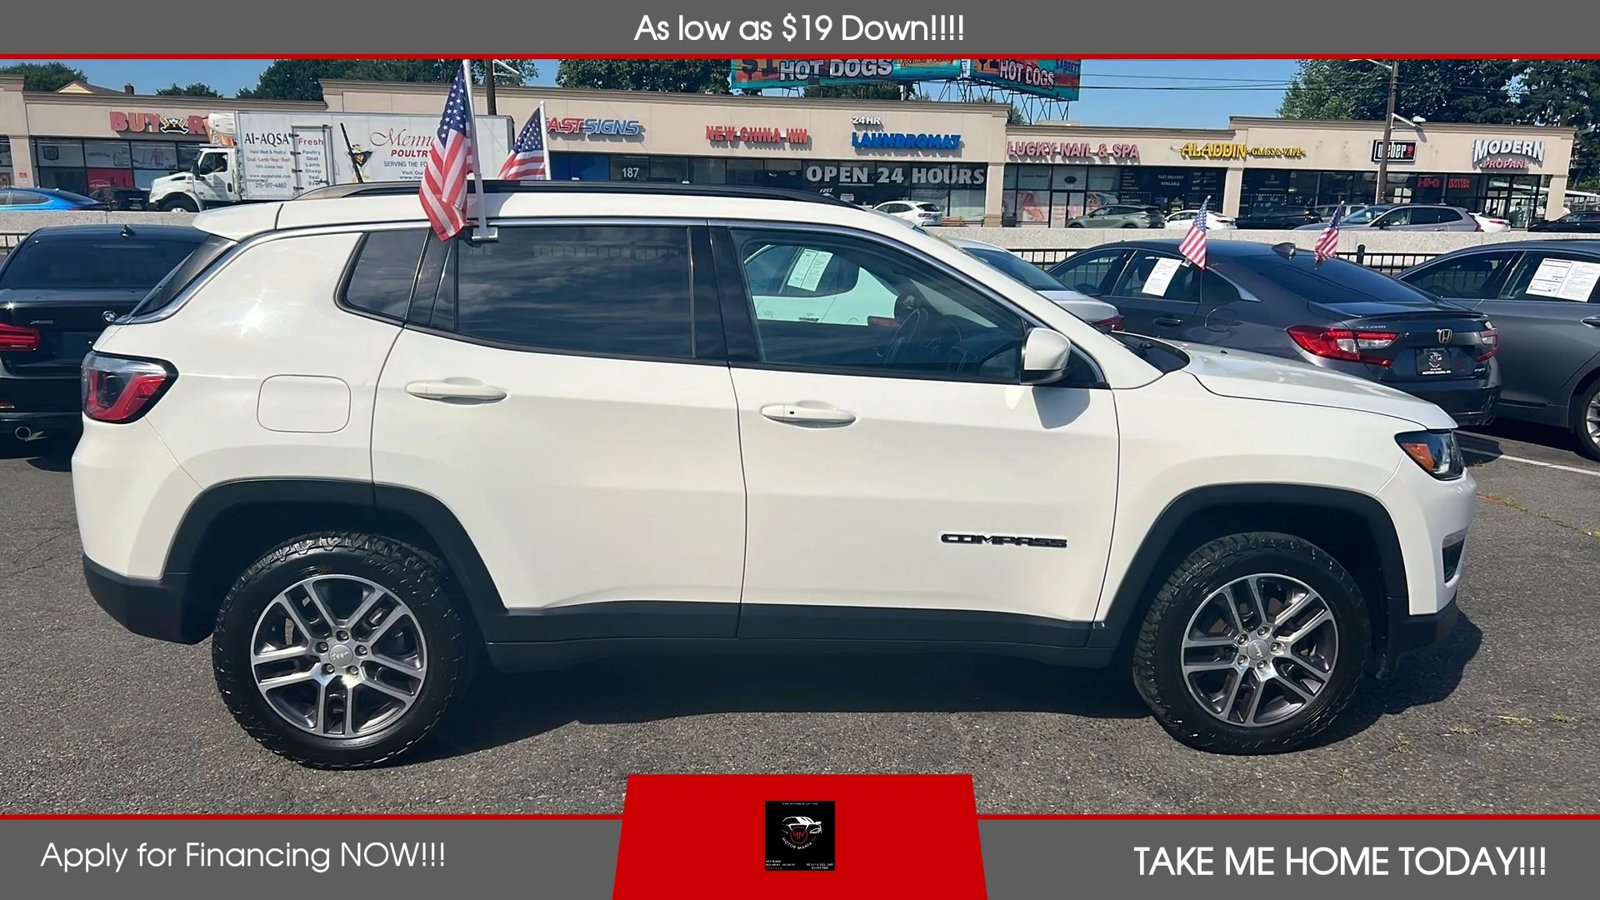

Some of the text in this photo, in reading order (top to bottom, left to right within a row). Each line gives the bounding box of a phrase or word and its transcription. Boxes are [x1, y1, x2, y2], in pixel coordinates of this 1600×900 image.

[779, 59, 893, 82] HOT DOGS
[999, 58, 1024, 82] HOT
[1024, 65, 1055, 87] DOGS
[109, 111, 160, 133] BUY
[545, 117, 640, 136] ASTSIGNS
[298, 137, 324, 146] Fresh
[706, 126, 808, 144] NEW CHINA INN
[851, 131, 962, 151] LAUNDROMAT
[391, 149, 431, 158] POULTR
[1007, 141, 1139, 158] LUCKY NAIL & SPA
[1181, 143, 1246, 159] ALADDIN
[1473, 139, 1545, 162] MODERN
[383, 160, 407, 168] SERVING
[621, 166, 640, 179] 187
[1482, 159, 1529, 169] PROPANE
[806, 166, 985, 185] OPEN 24 HOURS
[940, 533, 1068, 549] COMPASS
